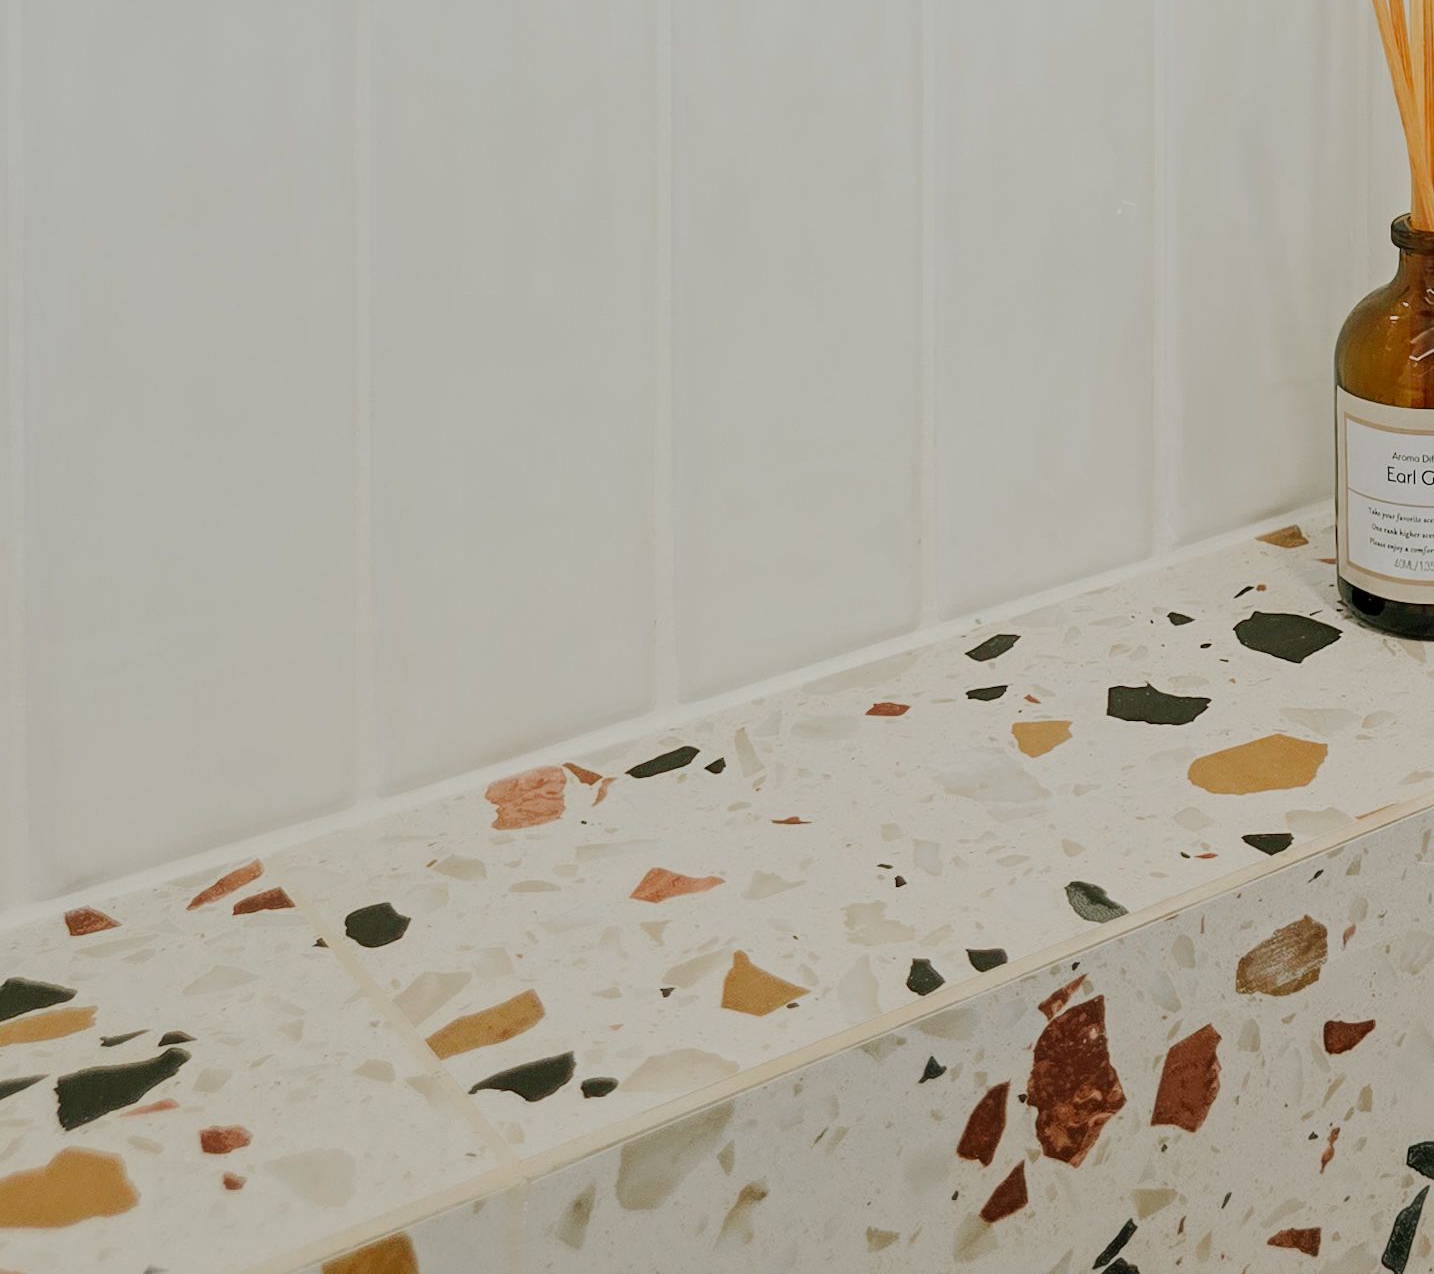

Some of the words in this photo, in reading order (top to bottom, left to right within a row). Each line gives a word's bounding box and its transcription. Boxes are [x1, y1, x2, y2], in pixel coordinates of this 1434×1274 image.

[1392, 452, 1420, 462] Aroma
[1387, 466, 1416, 485] Earl
[1368, 507, 1381, 516] Take
[1382, 512, 1395, 520] your
[1396, 513, 1421, 522] favorite
[1371, 523, 1382, 532] One
[1399, 528, 1420, 539] higher
[1369, 537, 1385, 547] Please
[1387, 543, 1403, 553] enjoy
